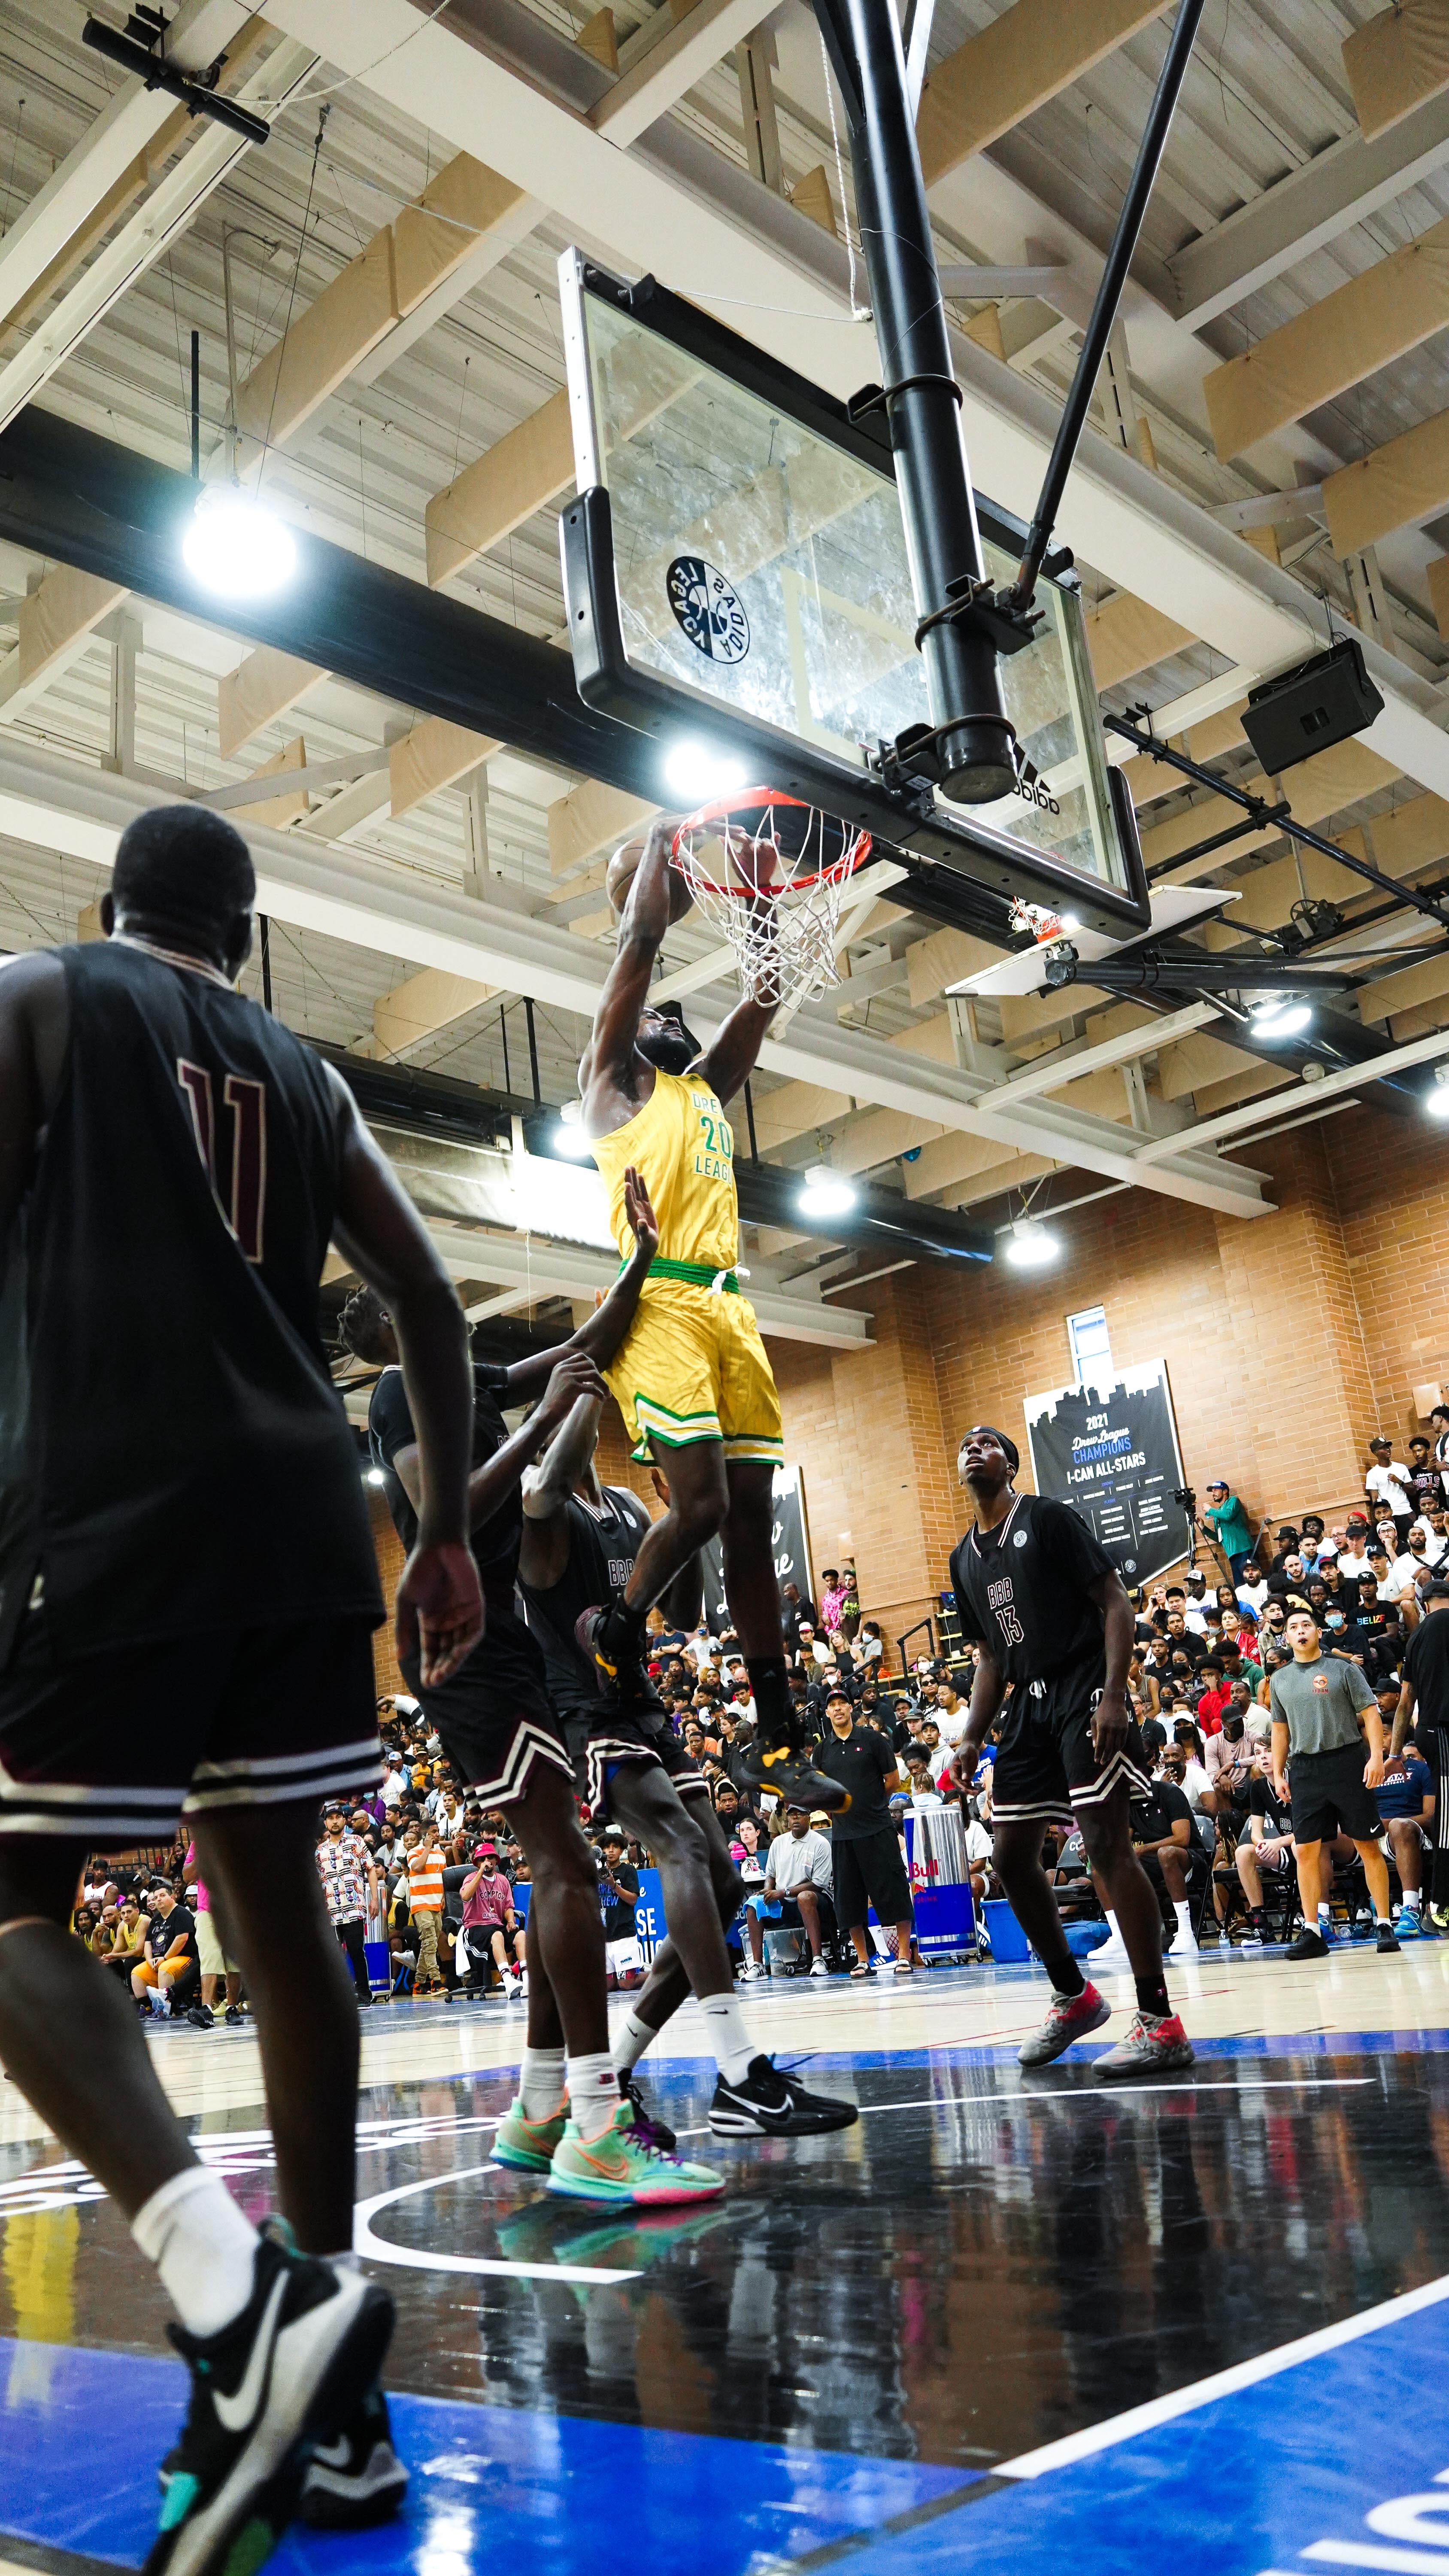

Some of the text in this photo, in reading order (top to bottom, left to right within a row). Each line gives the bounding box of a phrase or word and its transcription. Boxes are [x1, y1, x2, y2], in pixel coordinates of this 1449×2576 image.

[700, 1116, 732, 1159] 20
[177, 1057, 267, 1263] 11
[696, 1155, 732, 1184] LEAG
[1086, 1413, 1109, 1431] 2021
[1071, 1427, 1130, 1451] Drew League
[1073, 1437, 1132, 1464] CHAMPIONS
[1067, 1452, 1146, 1485] I-CAN ALL-STARS
[988, 1577, 1013, 1609] BBB
[995, 1605, 1025, 1647] 13
[1357, 1614, 1385, 1625] BELIZE
[912, 1859, 939, 1878] Bull
[479, 1890, 506, 1900] COMPTON
